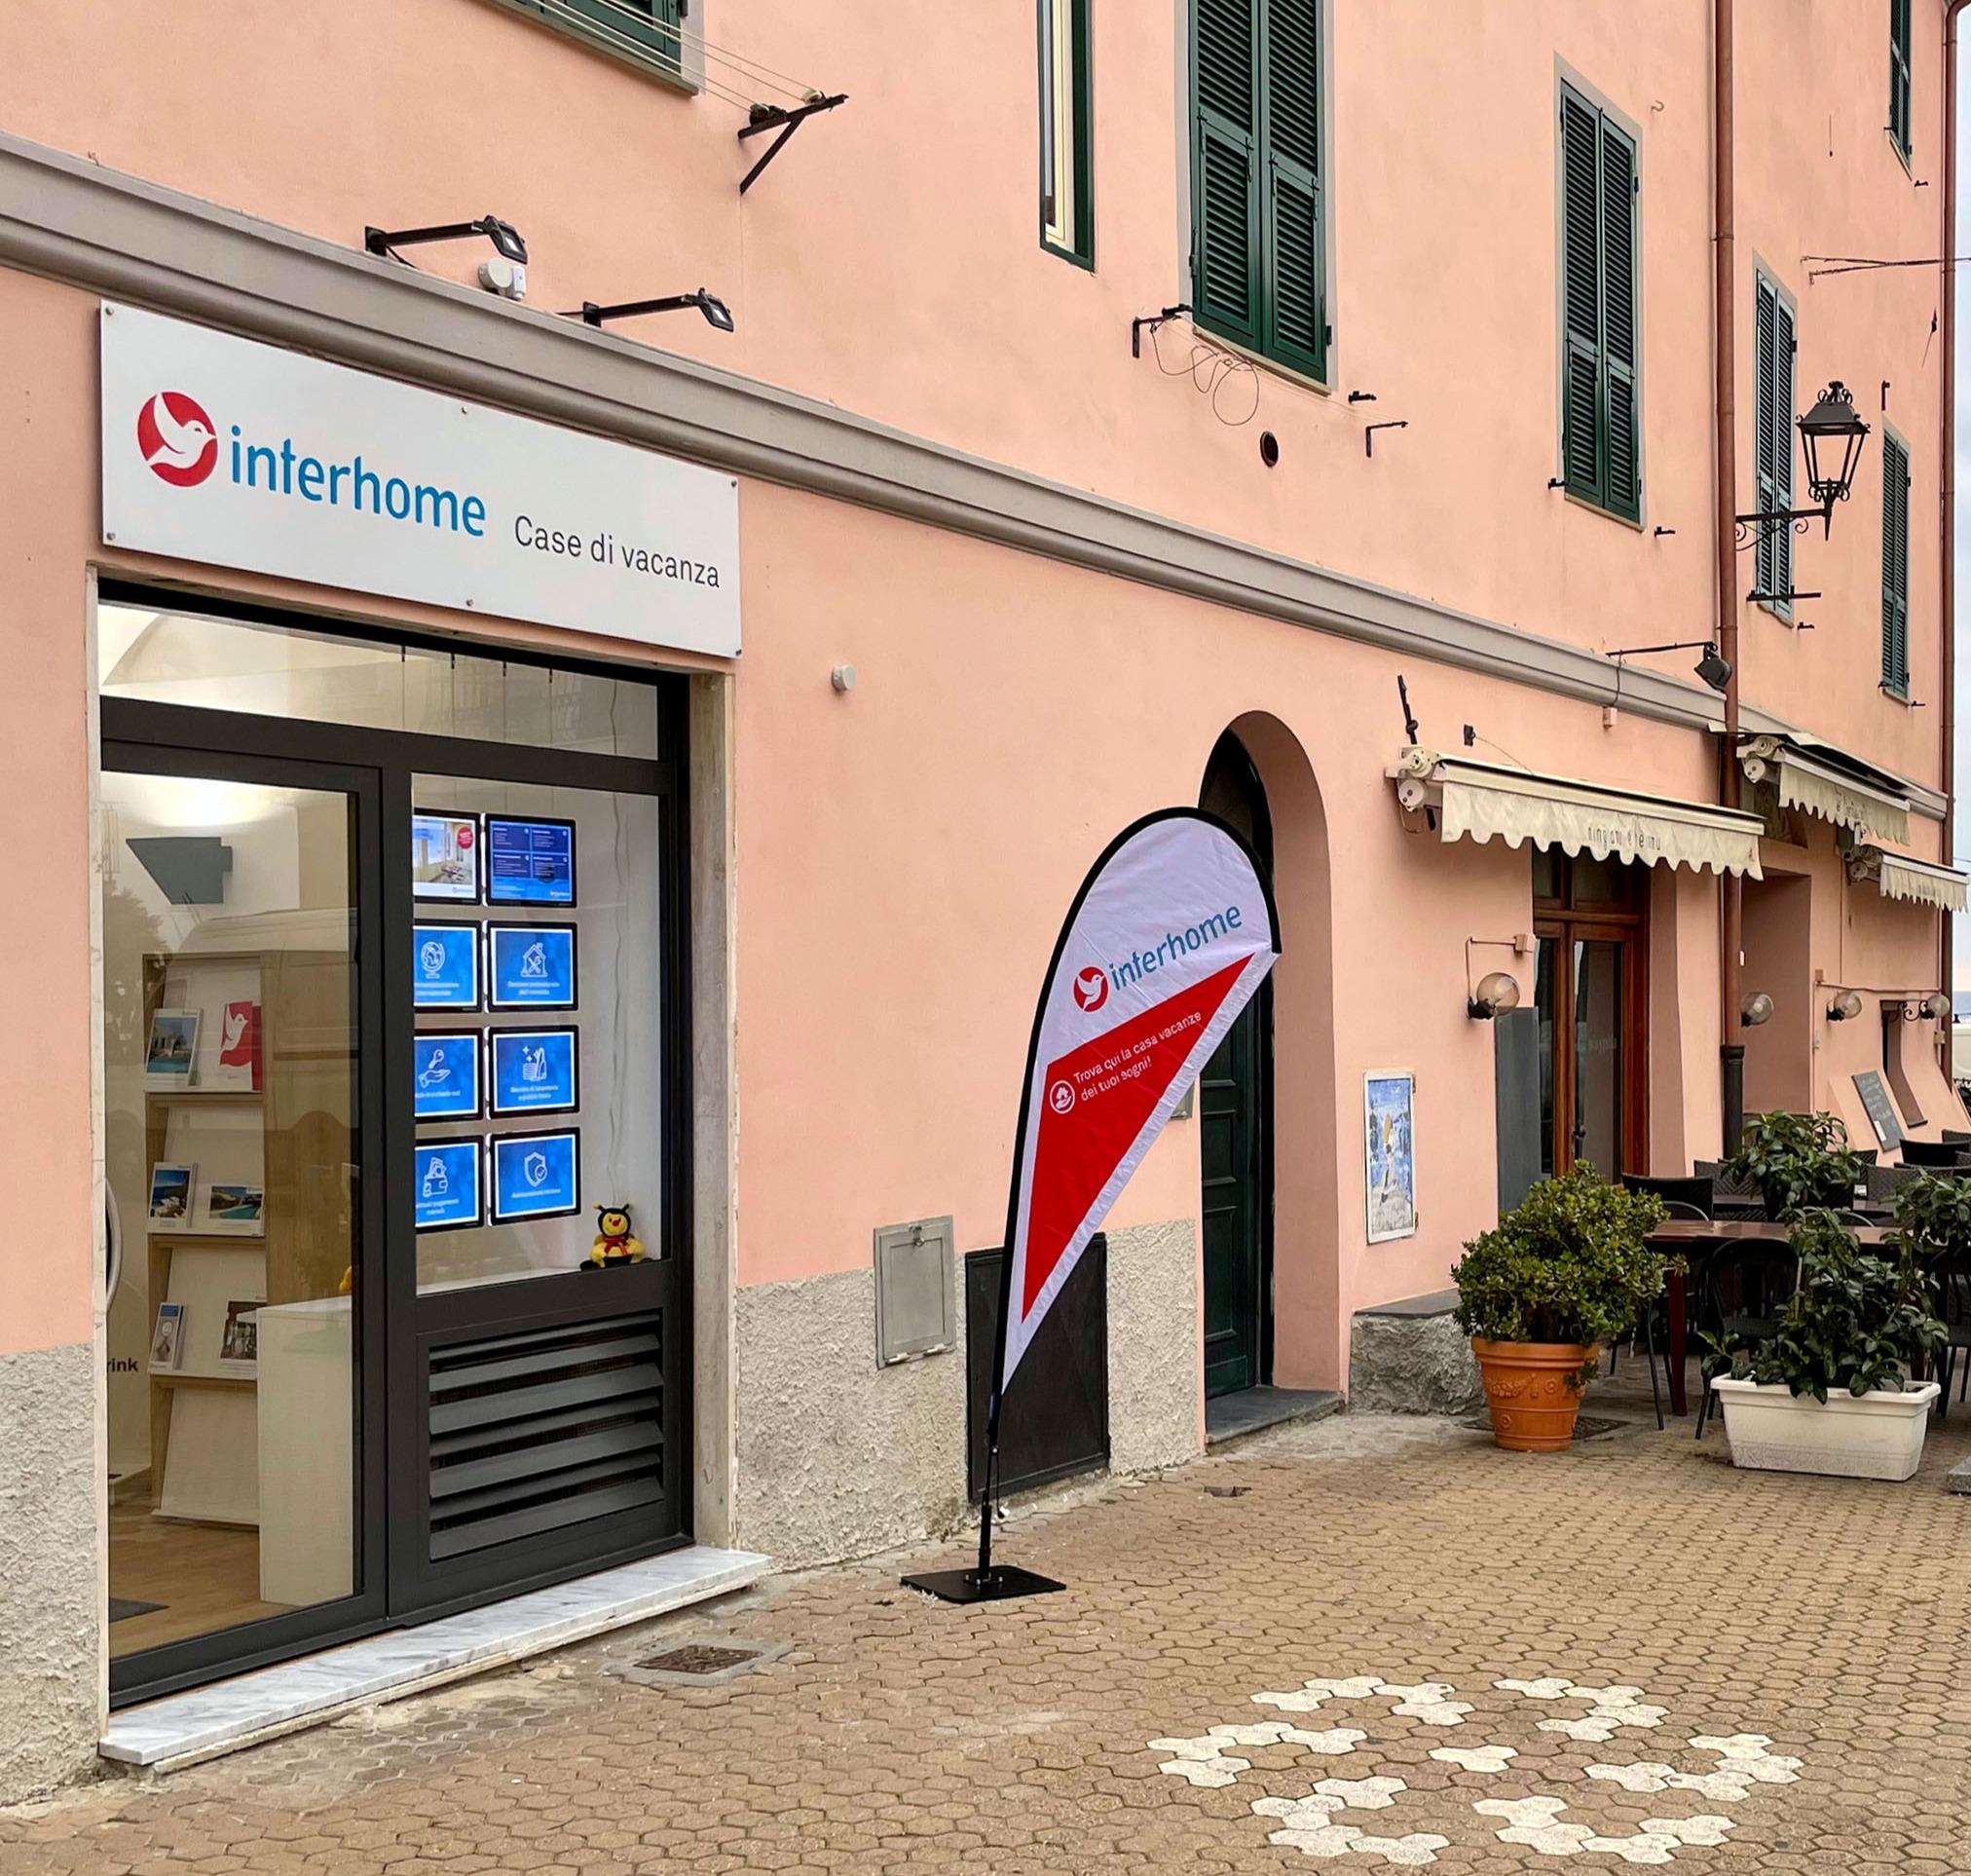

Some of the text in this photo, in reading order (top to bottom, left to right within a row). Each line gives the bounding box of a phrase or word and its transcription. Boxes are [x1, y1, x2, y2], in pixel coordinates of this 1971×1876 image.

[231, 426, 486, 538] interhome
[513, 515, 721, 588] Case di vacanza
[1109, 906, 1243, 991] interhome
[1073, 1010, 1203, 1084] Trova qui la casa vacanze
[1080, 1055, 1152, 1103] dei tuoi sogni!
